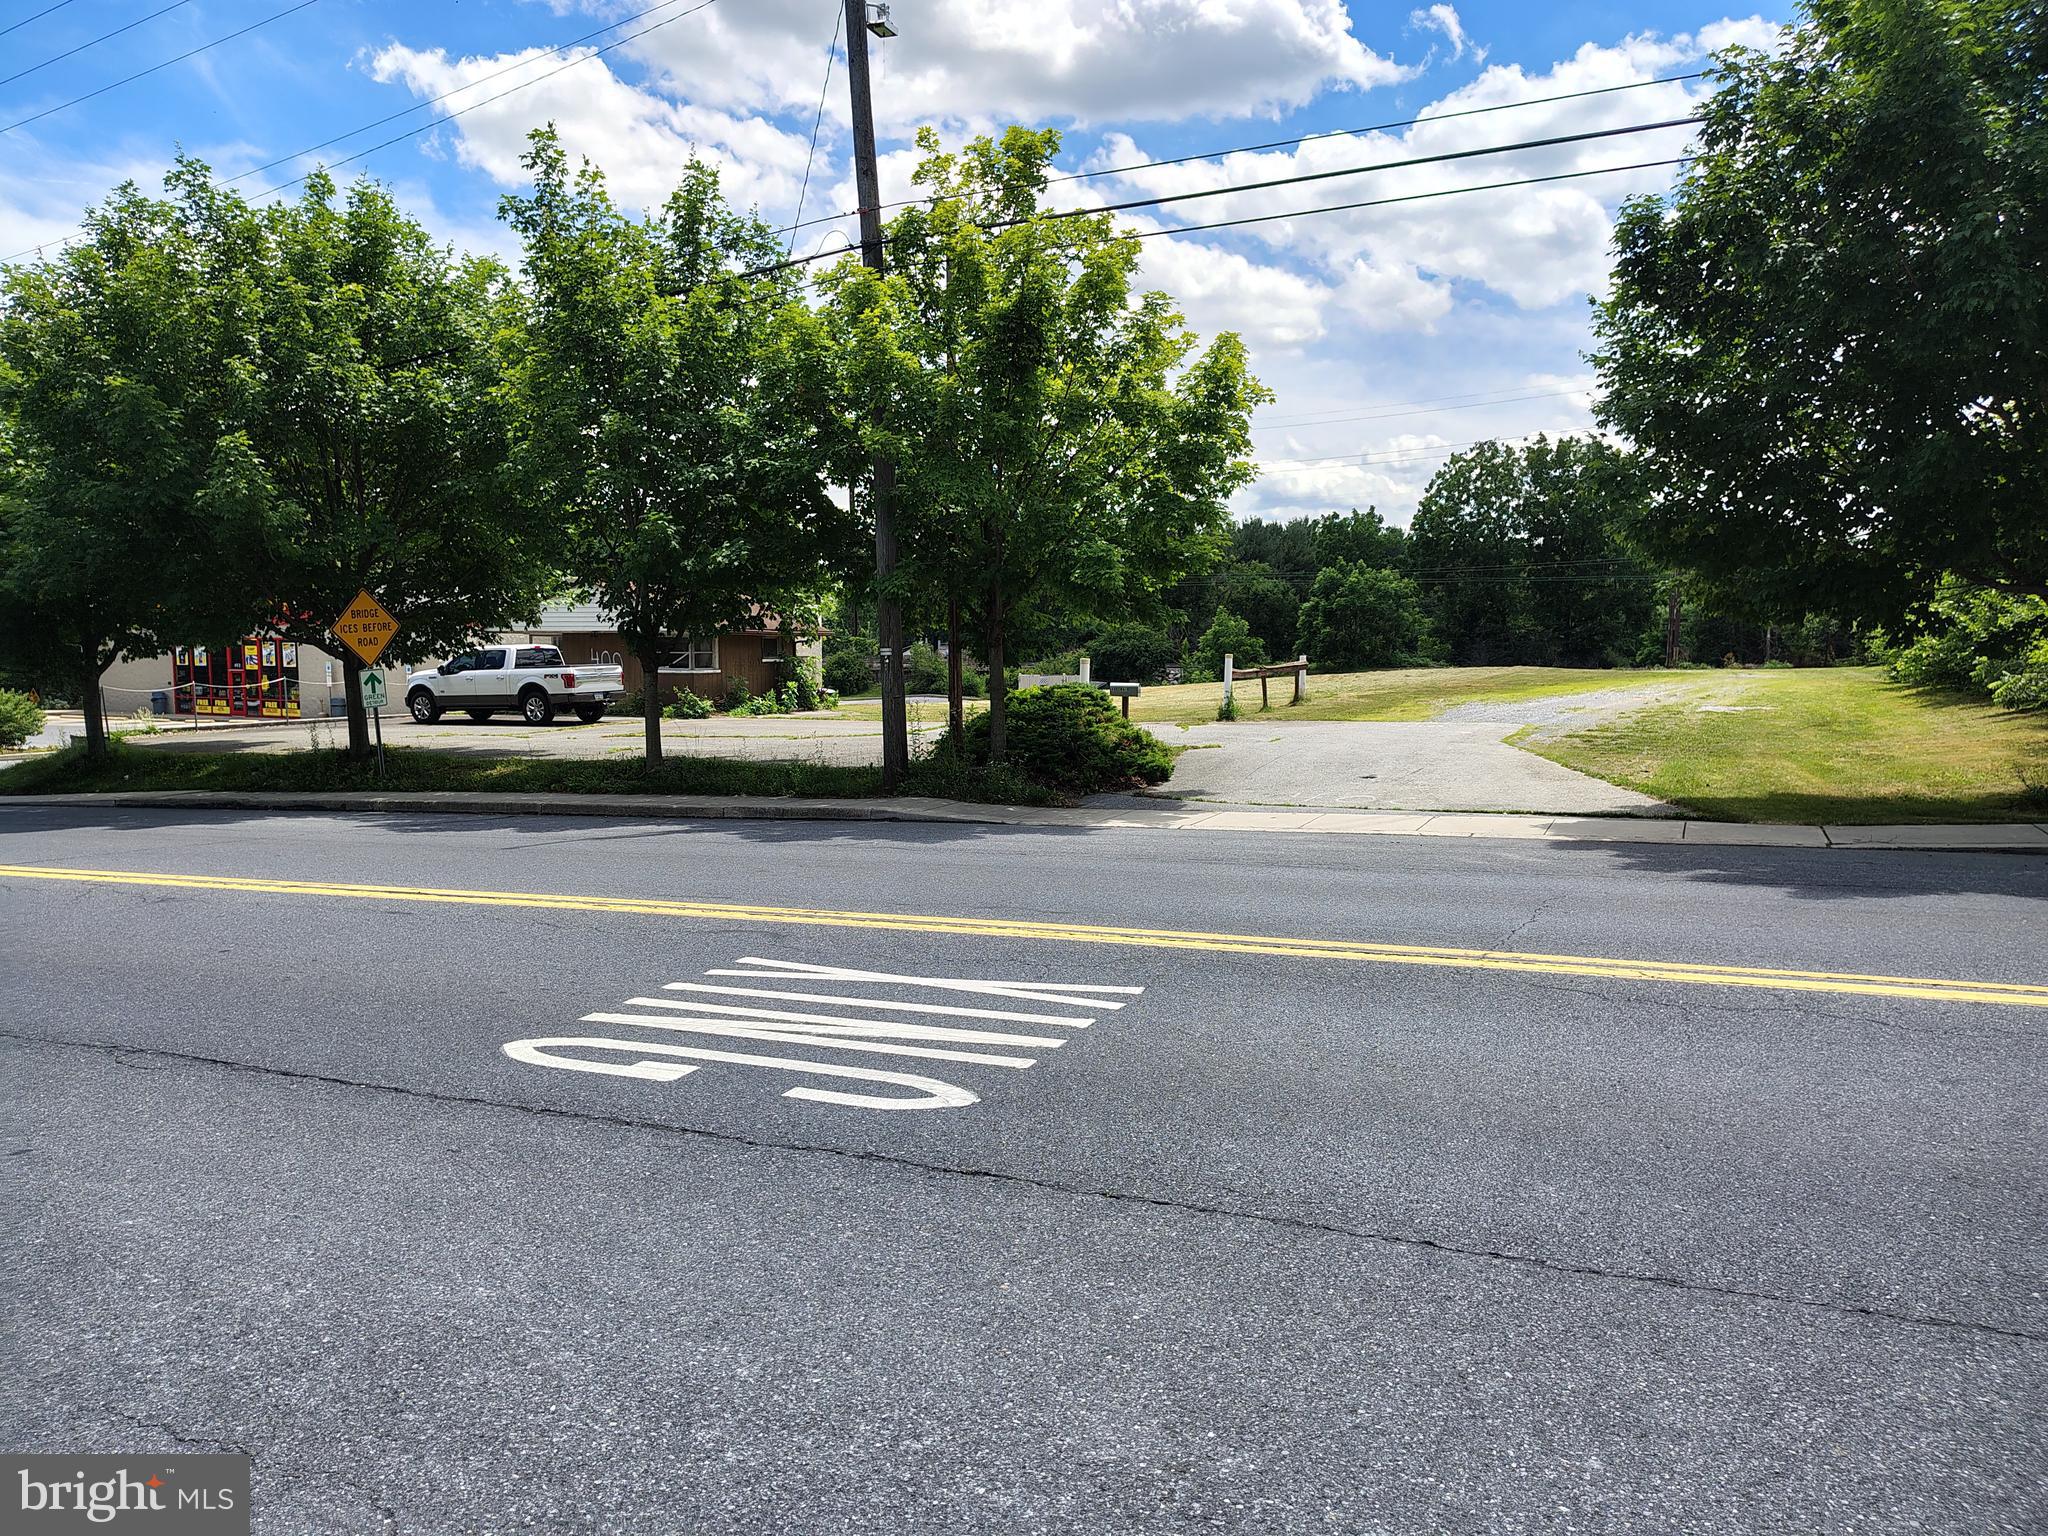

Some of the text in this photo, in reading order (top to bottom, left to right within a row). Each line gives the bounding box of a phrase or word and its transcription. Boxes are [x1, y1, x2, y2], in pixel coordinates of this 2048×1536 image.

[350, 608, 380, 619] BRIDGE
[339, 621, 393, 634] ICES BEFORE
[357, 637, 379, 647] ROAD
[363, 693, 385, 701] GREEN
[501, 956, 1146, 1112] XING
